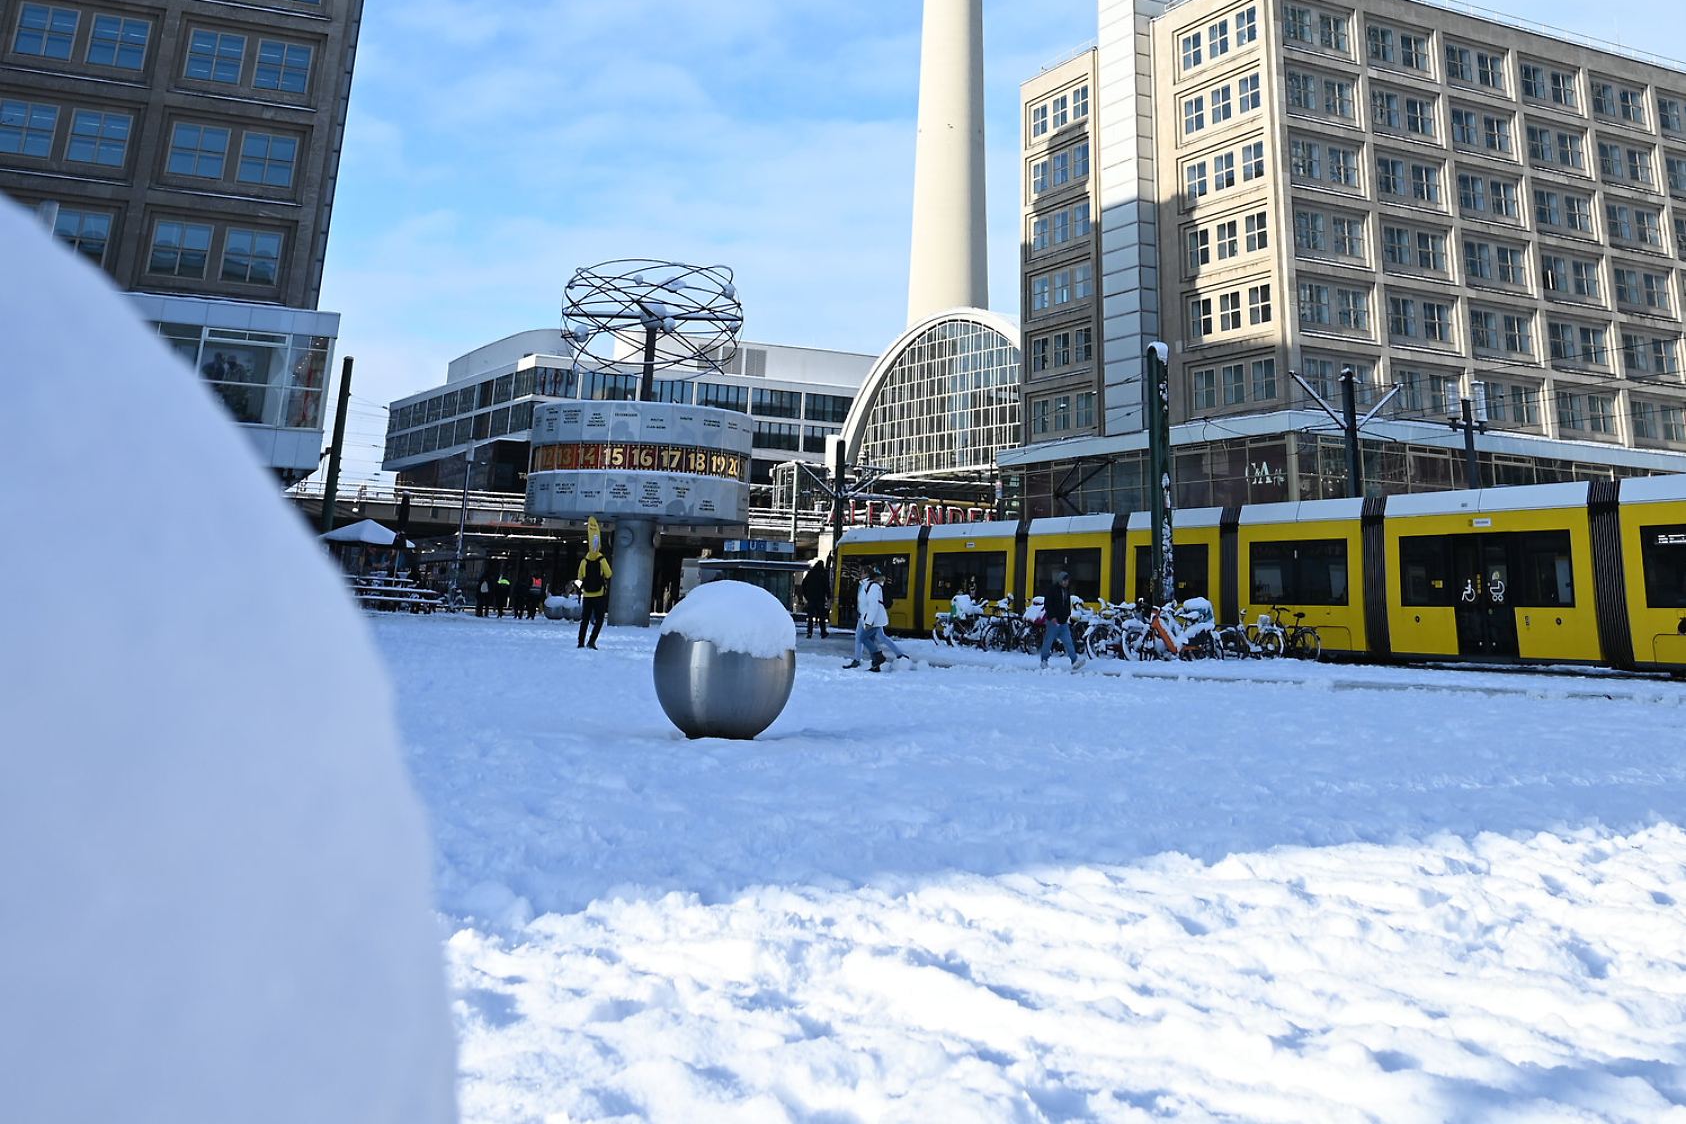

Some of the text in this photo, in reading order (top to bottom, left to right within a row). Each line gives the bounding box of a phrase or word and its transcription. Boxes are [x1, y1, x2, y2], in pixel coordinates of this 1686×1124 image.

[558, 448, 572, 465] 13
[578, 447, 595, 465] 14
[603, 447, 624, 466] 15
[631, 449, 653, 468] 16
[661, 450, 681, 468] 17
[688, 453, 706, 472] 18
[711, 455, 726, 473] 19
[728, 457, 738, 476] 20
